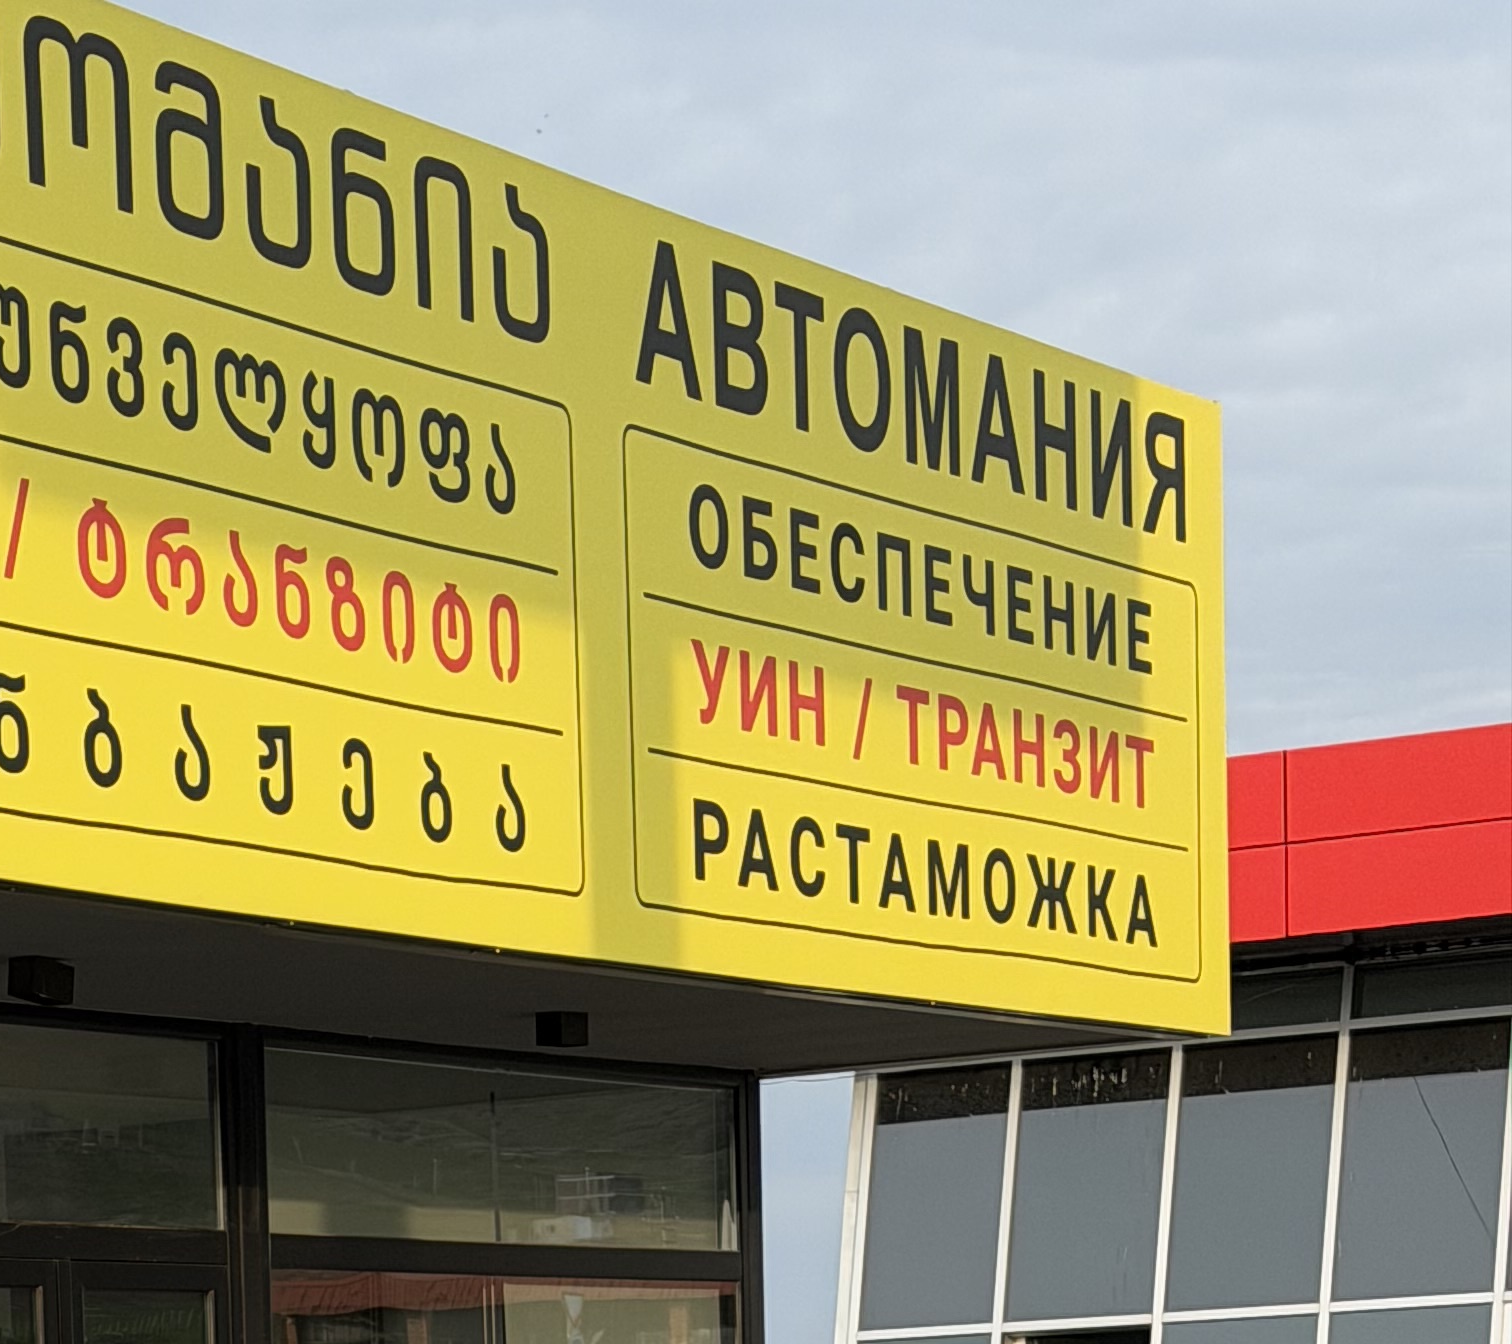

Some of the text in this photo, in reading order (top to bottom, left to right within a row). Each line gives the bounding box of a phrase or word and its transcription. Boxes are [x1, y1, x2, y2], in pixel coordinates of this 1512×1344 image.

[635, 239, 1187, 543] АВТОМАНИЯ
[4, 478, 29, 580] /
[76, 498, 521, 685] ტრანზიტი
[689, 483, 1153, 675] ОБЕСПЕЧЕНИЕ
[691, 638, 1155, 810] УИН / ТРАНЗИТ
[692, 798, 1158, 948] РАСТАМОЖКА
